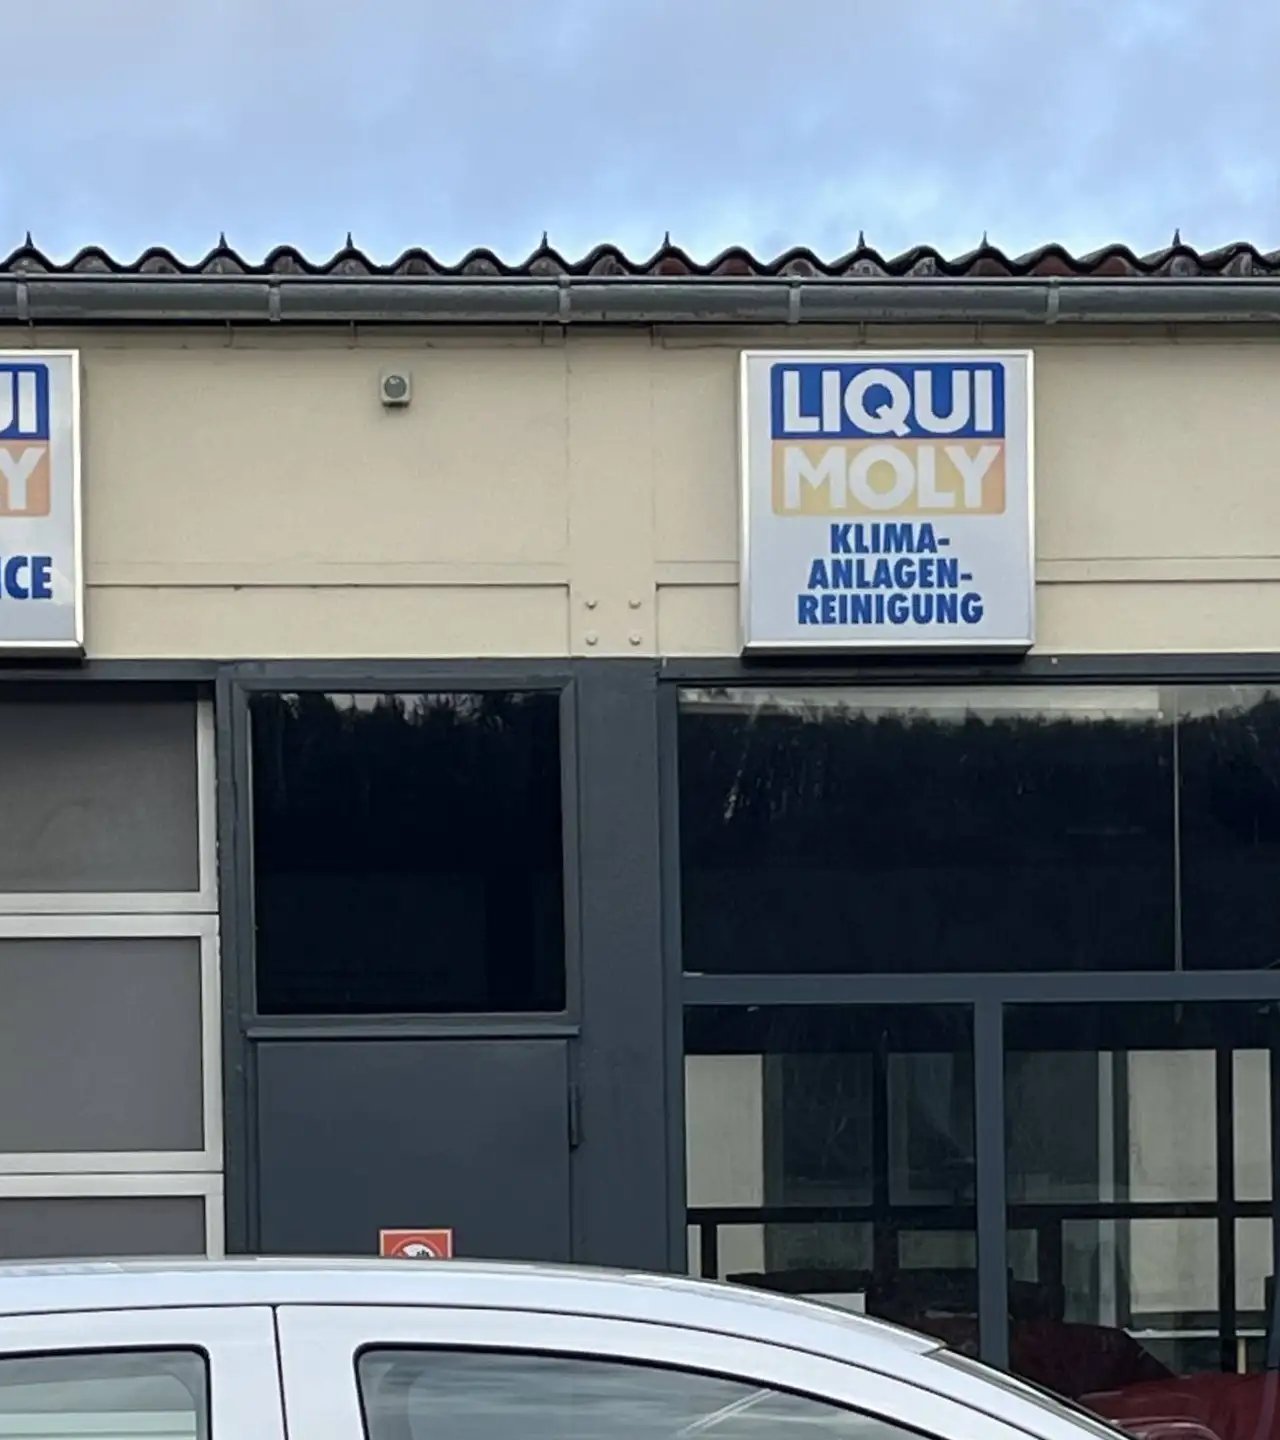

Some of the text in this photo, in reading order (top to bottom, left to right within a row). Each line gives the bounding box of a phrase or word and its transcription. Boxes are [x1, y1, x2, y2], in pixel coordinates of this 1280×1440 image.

[783, 369, 993, 437] LIQUI
[784, 445, 1001, 510] MOLY
[830, 523, 950, 553] KLIMA-
[807, 558, 972, 589] ANLAGEN-
[798, 593, 984, 625] REINIGUNG
